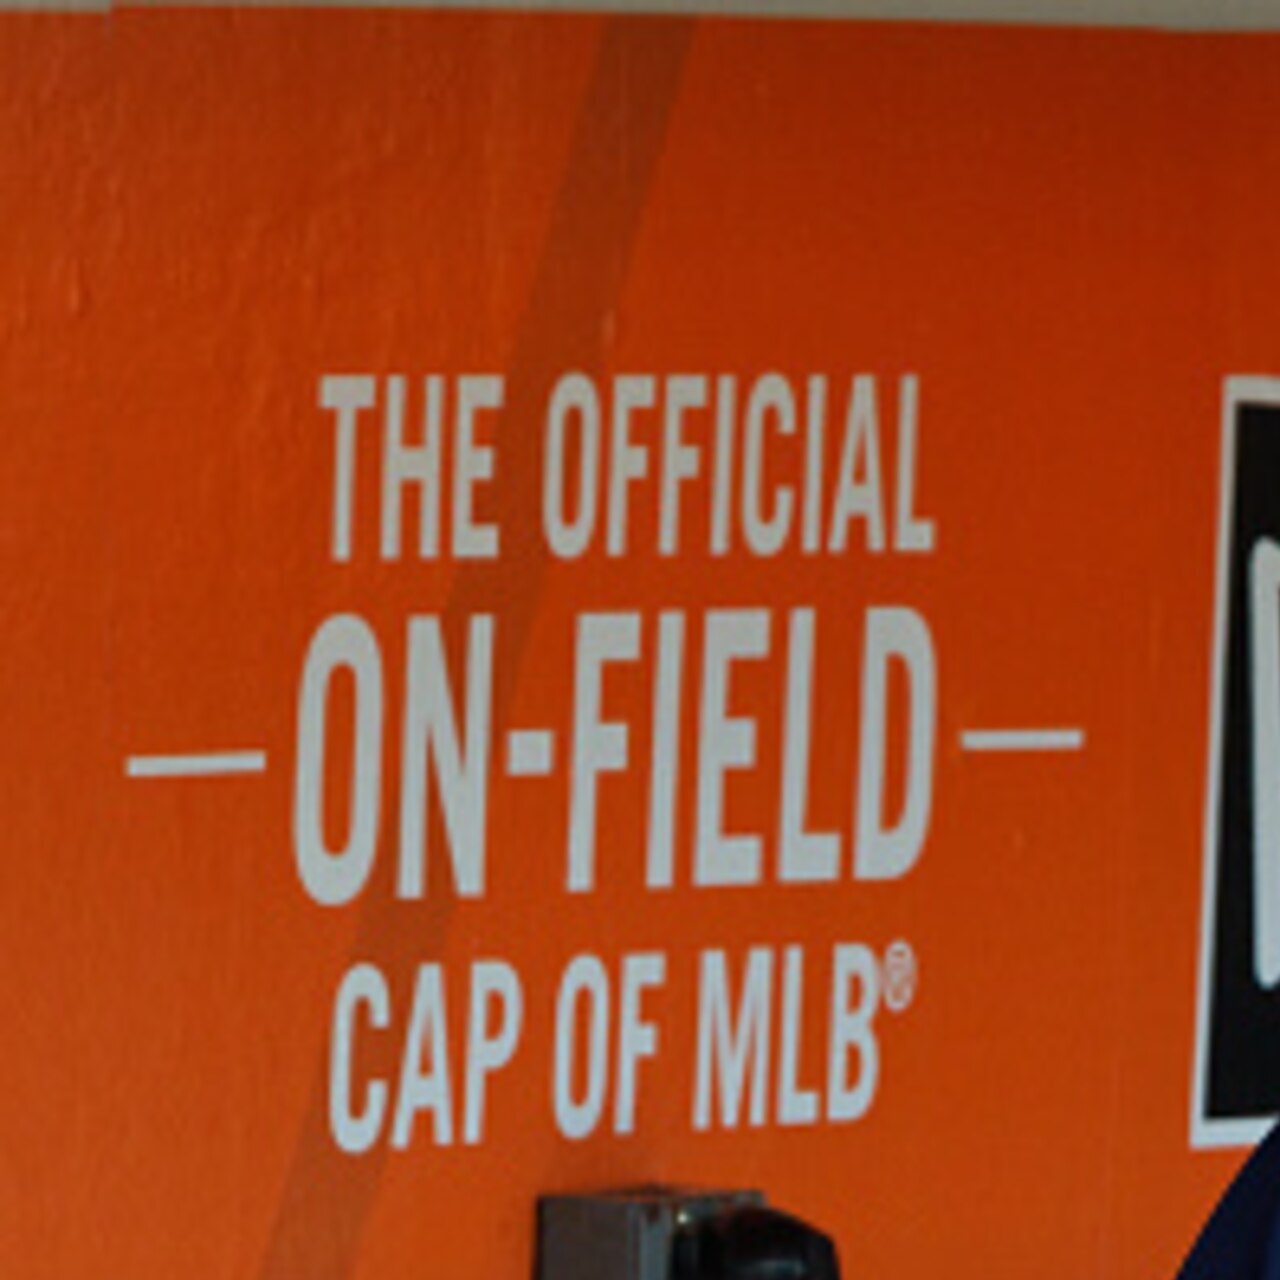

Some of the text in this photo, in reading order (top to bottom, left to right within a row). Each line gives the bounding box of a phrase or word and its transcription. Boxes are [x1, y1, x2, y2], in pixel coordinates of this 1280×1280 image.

[319, 373, 935, 562] THE OFFICIAL
[293, 606, 937, 907] ON-FIELD
[328, 959, 524, 1155] CAP
[552, 951, 667, 1140] OF
